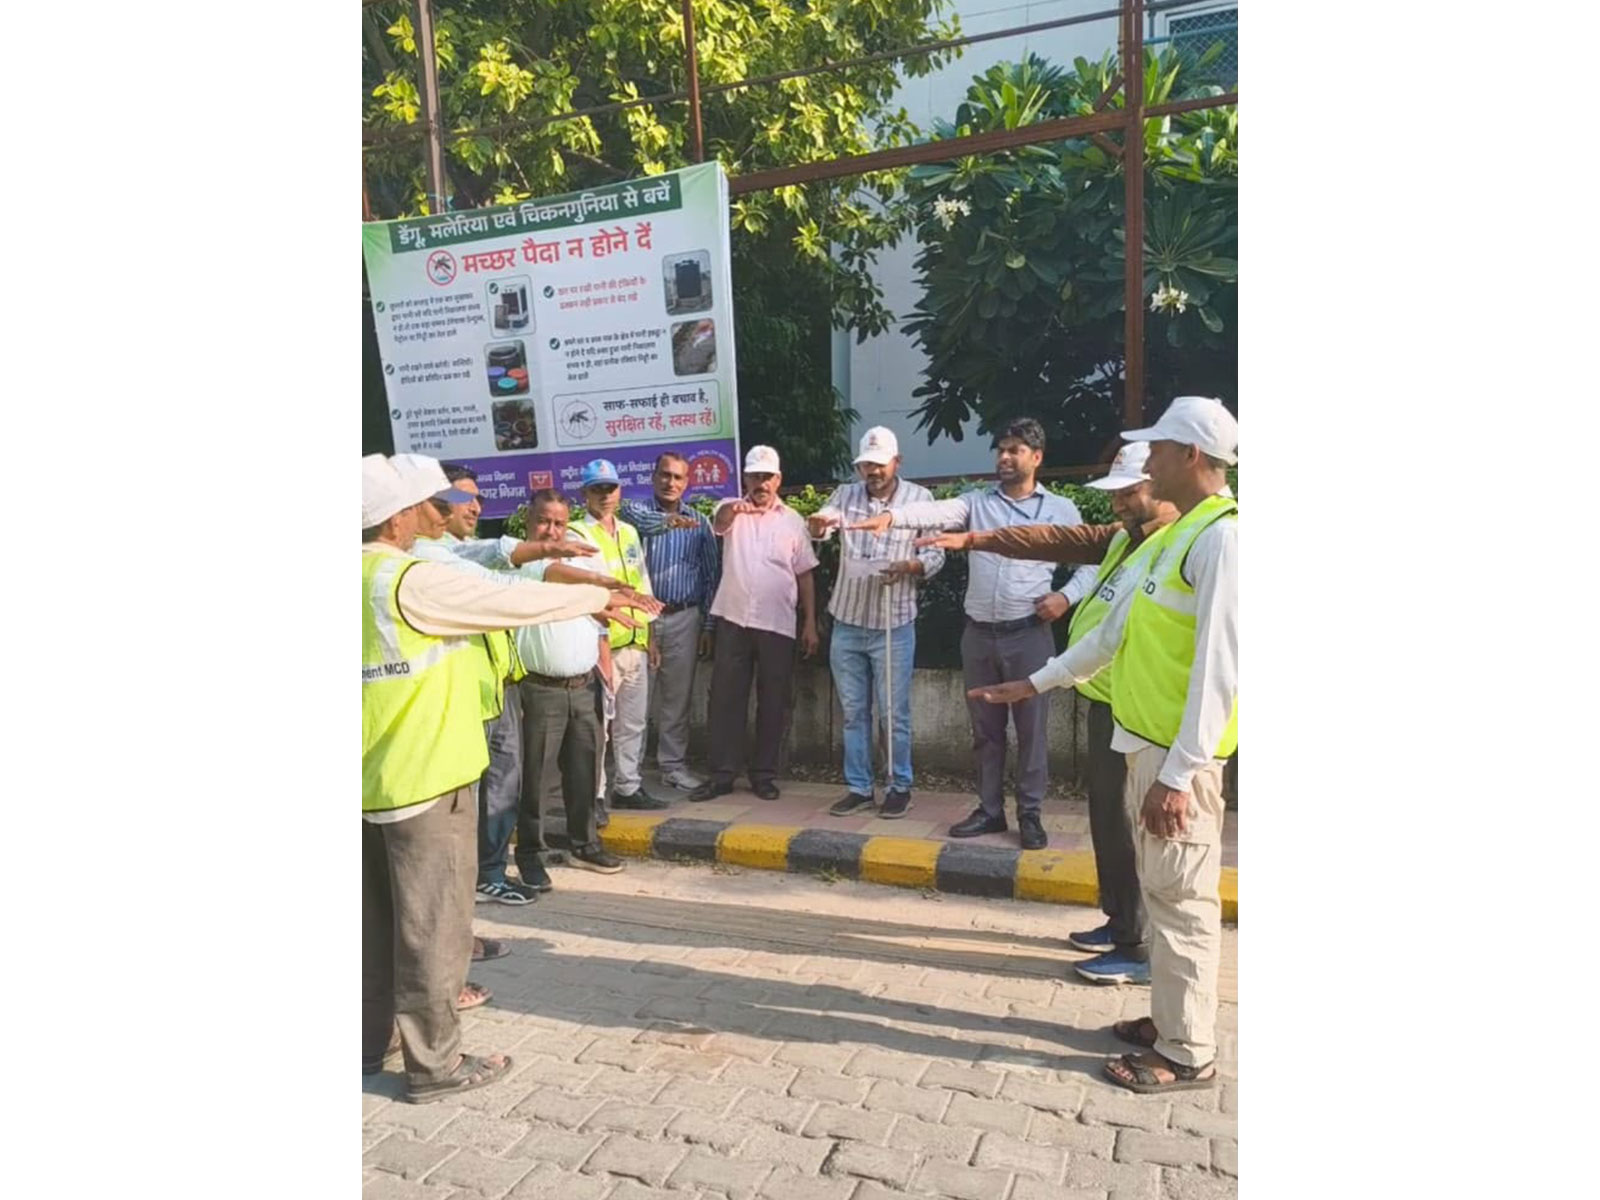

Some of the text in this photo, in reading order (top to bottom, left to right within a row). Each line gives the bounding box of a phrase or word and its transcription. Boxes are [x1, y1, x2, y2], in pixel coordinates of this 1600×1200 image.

[398, 180, 671, 247] डेंगू, मलेरिया एवं चिकनगुनिया से बचें
[461, 222, 652, 273] मच्छर पैदा न होने दें
[603, 388, 709, 412] साफ-सफाई ही बचाव है,
[605, 414, 645, 437] सुरक्षित
[669, 412, 697, 428] स्वस्थ
[499, 483, 526, 499] निगम
[384, 661, 410, 676] MCD
